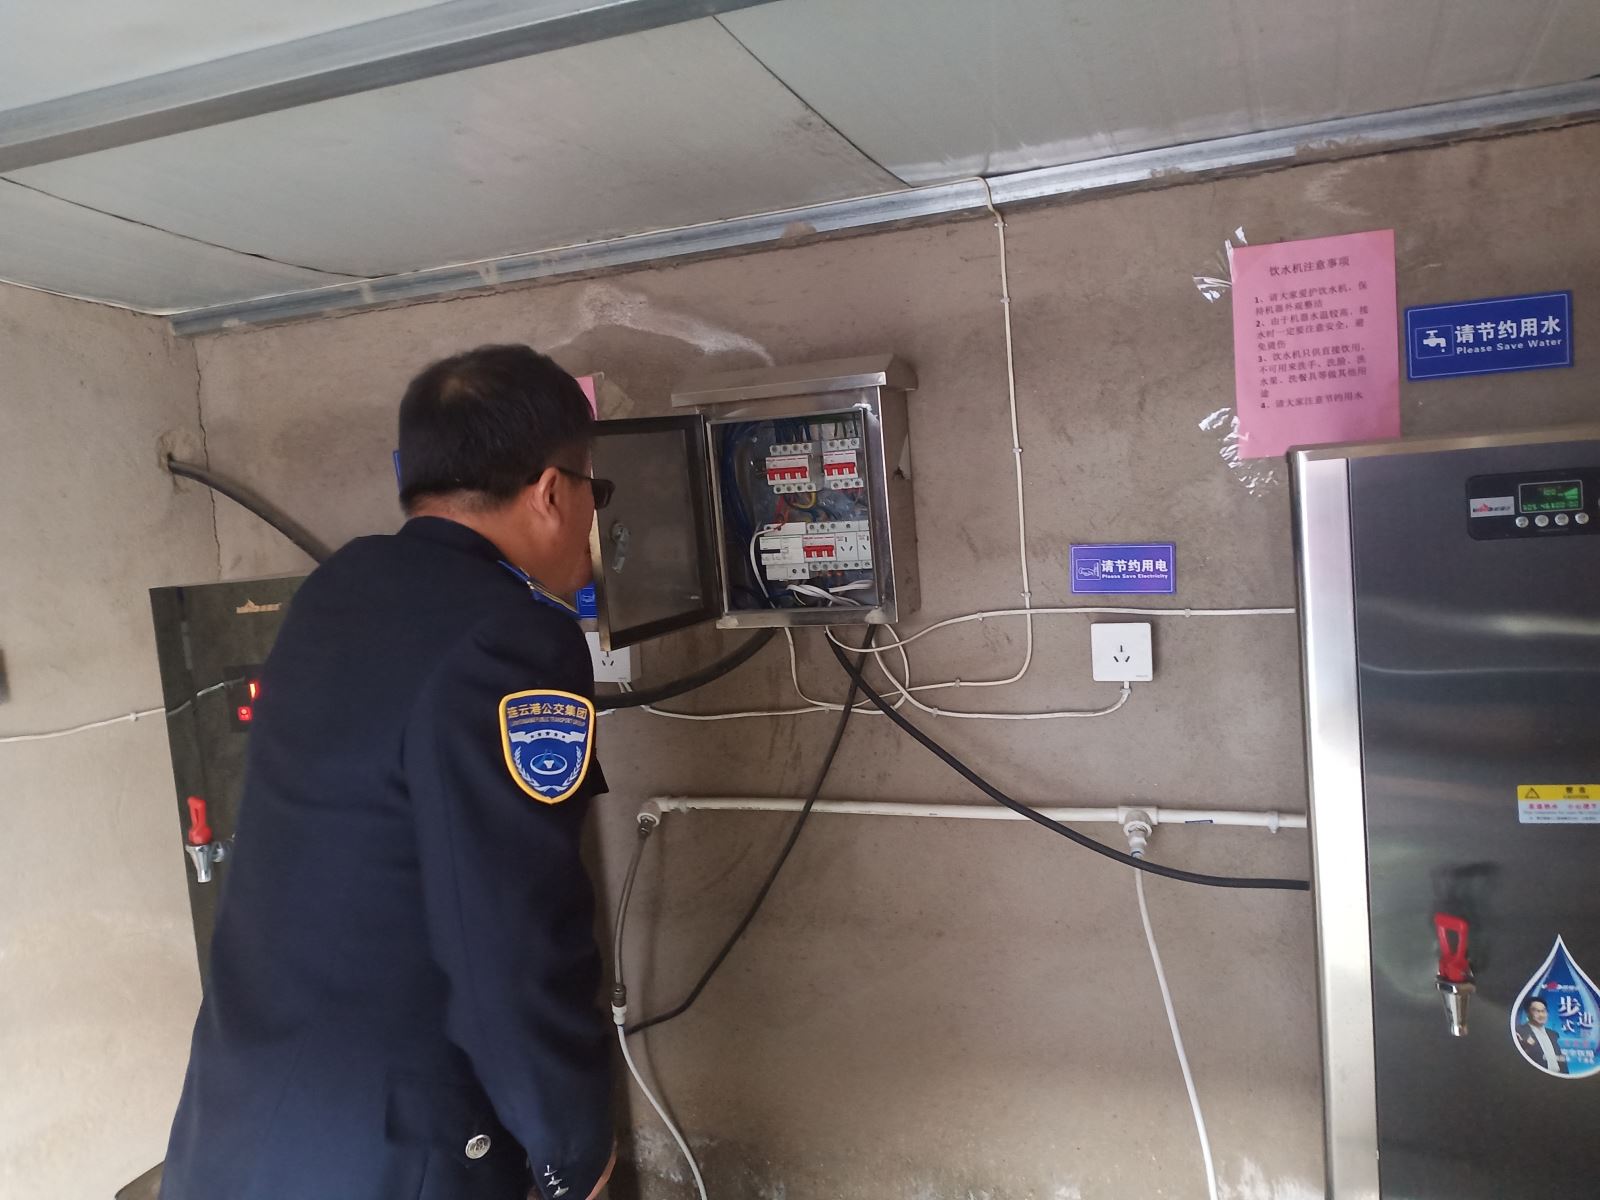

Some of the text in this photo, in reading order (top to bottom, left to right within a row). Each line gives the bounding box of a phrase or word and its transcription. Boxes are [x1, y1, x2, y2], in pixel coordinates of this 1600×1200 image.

[1269, 256, 1350, 277] 饮水机注意事项
[1454, 315, 1562, 344] 请节约用水
[1456, 338, 1562, 355] Please Save Water
[1101, 559, 1168, 573] 请节约用电
